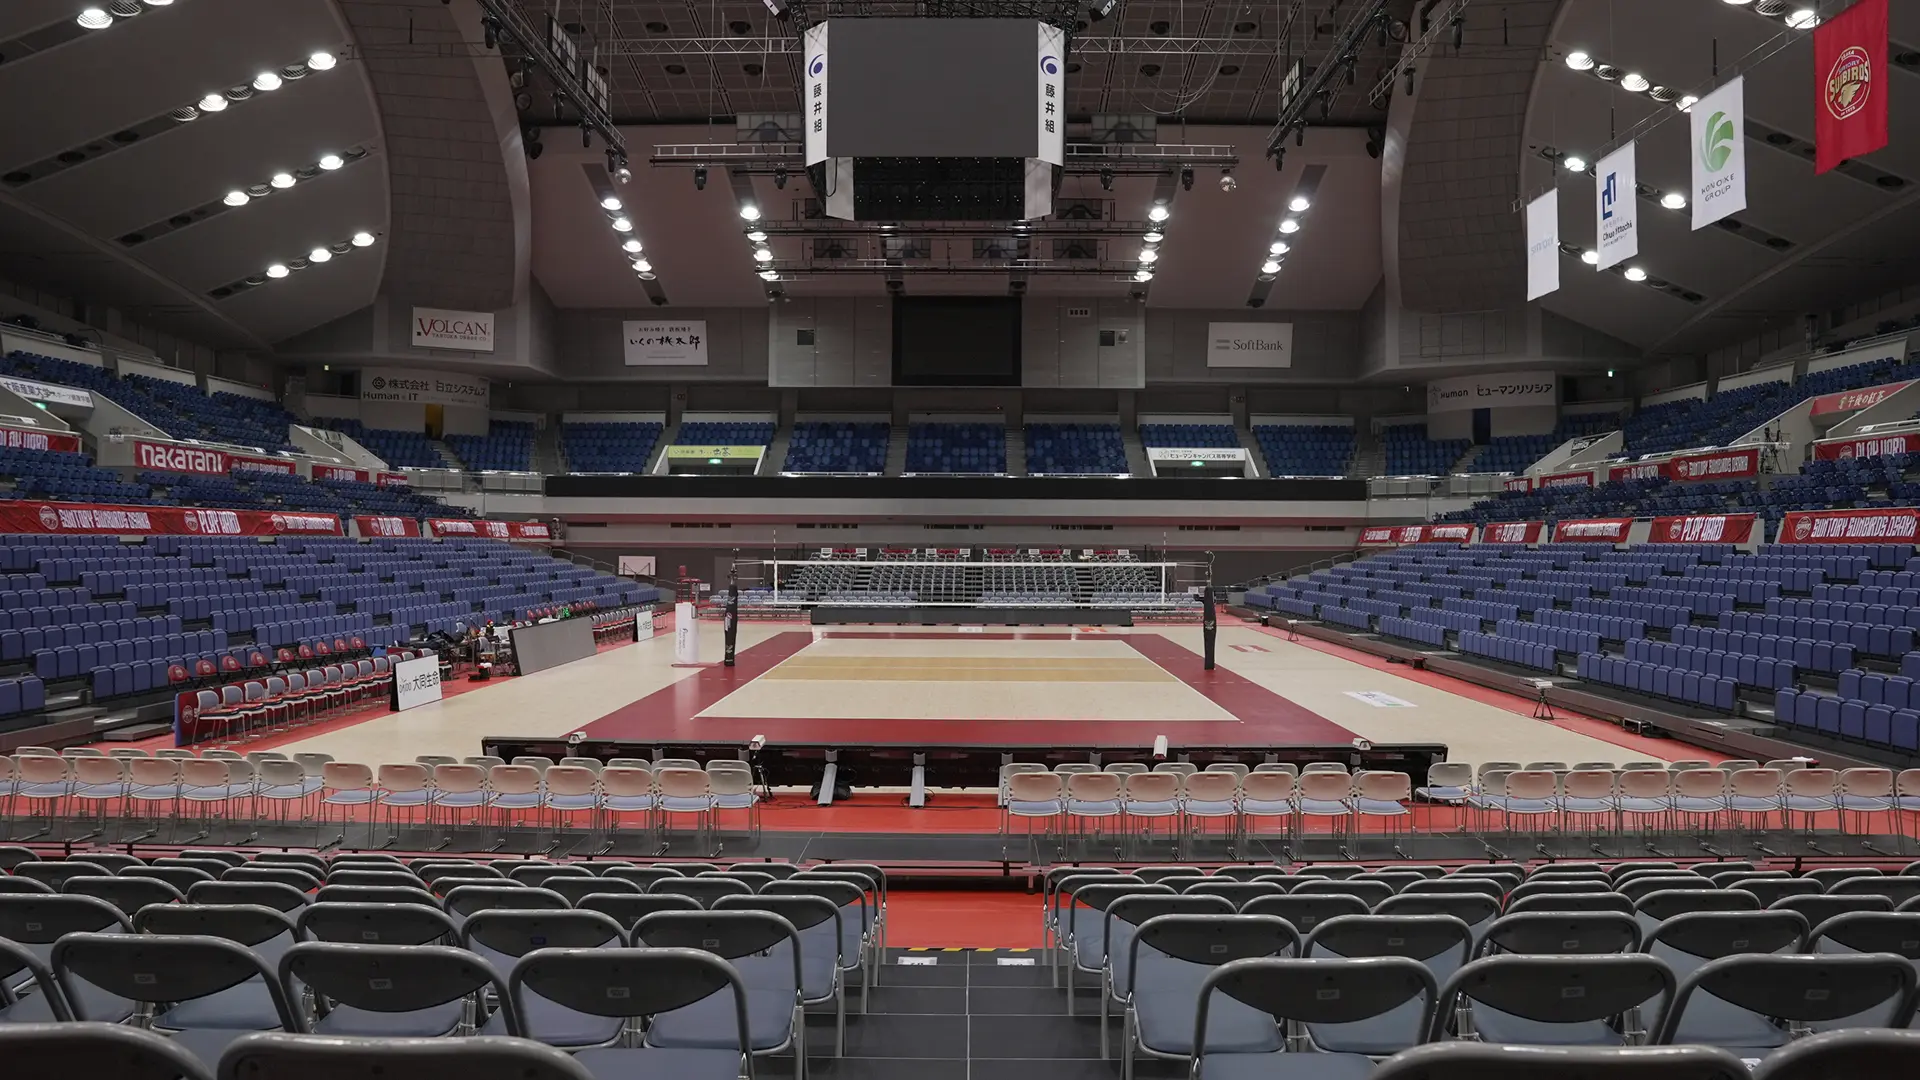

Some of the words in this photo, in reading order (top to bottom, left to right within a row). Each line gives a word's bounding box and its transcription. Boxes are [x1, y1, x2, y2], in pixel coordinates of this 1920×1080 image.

[814, 83, 822, 133] 藤井組
[1045, 83, 1055, 133] 藤井組
[1704, 184, 1731, 202] GROUP
[418, 317, 489, 337] VOLCAN
[1233, 339, 1284, 351] SoftBank
[362, 391, 400, 402] Human
[408, 393, 419, 402] IT
[388, 379, 430, 392] 株式会社
[436, 380, 487, 397] 日立システムズ
[1476, 383, 1553, 398] ヒューマンリソシア
[1681, 517, 1705, 541] PLAY
[1811, 517, 1849, 538] SUNTORY
[1846, 516, 1889, 537] SUNBIRDS
[1885, 515, 1918, 537] OSAKA
[412, 671, 440, 691] 大同生命
